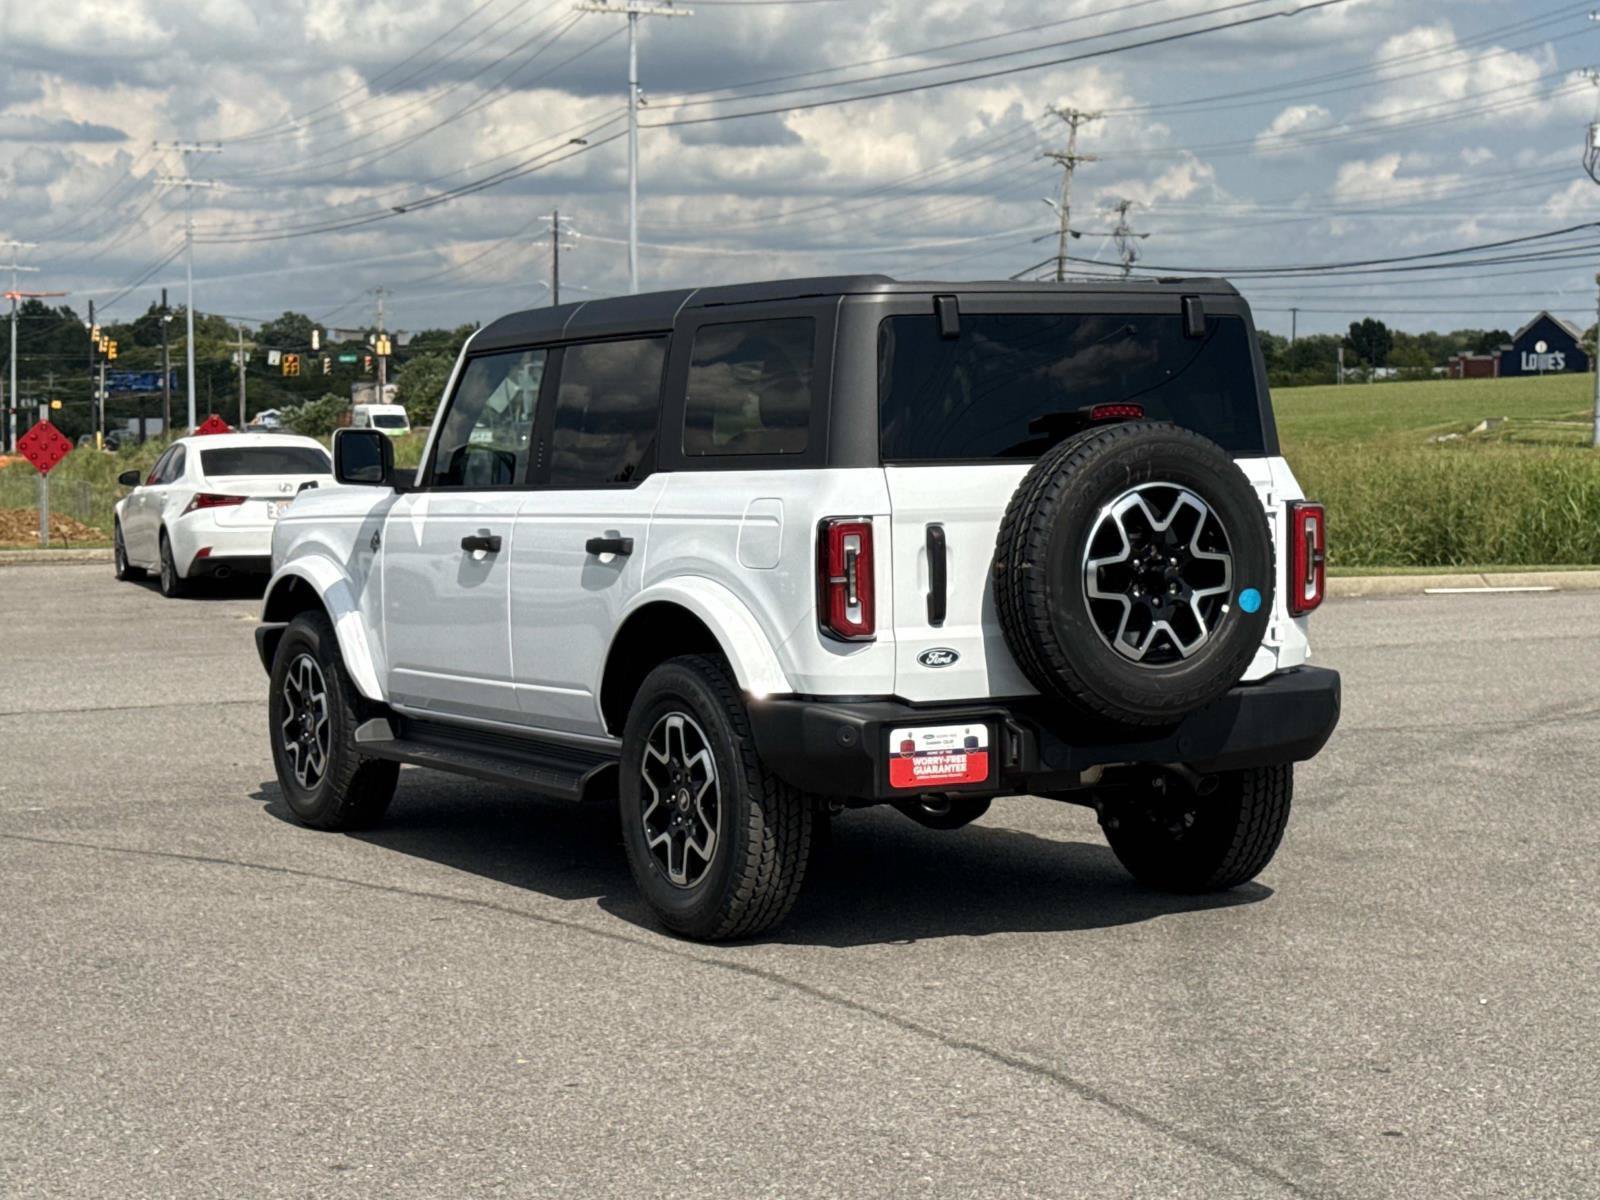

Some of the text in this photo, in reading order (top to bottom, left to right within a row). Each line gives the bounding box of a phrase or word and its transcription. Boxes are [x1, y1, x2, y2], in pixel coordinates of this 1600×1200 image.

[925, 651, 954, 664] Ford
[912, 754, 967, 766] WORRY-FREE
[912, 764, 967, 775] GUARANTEE
